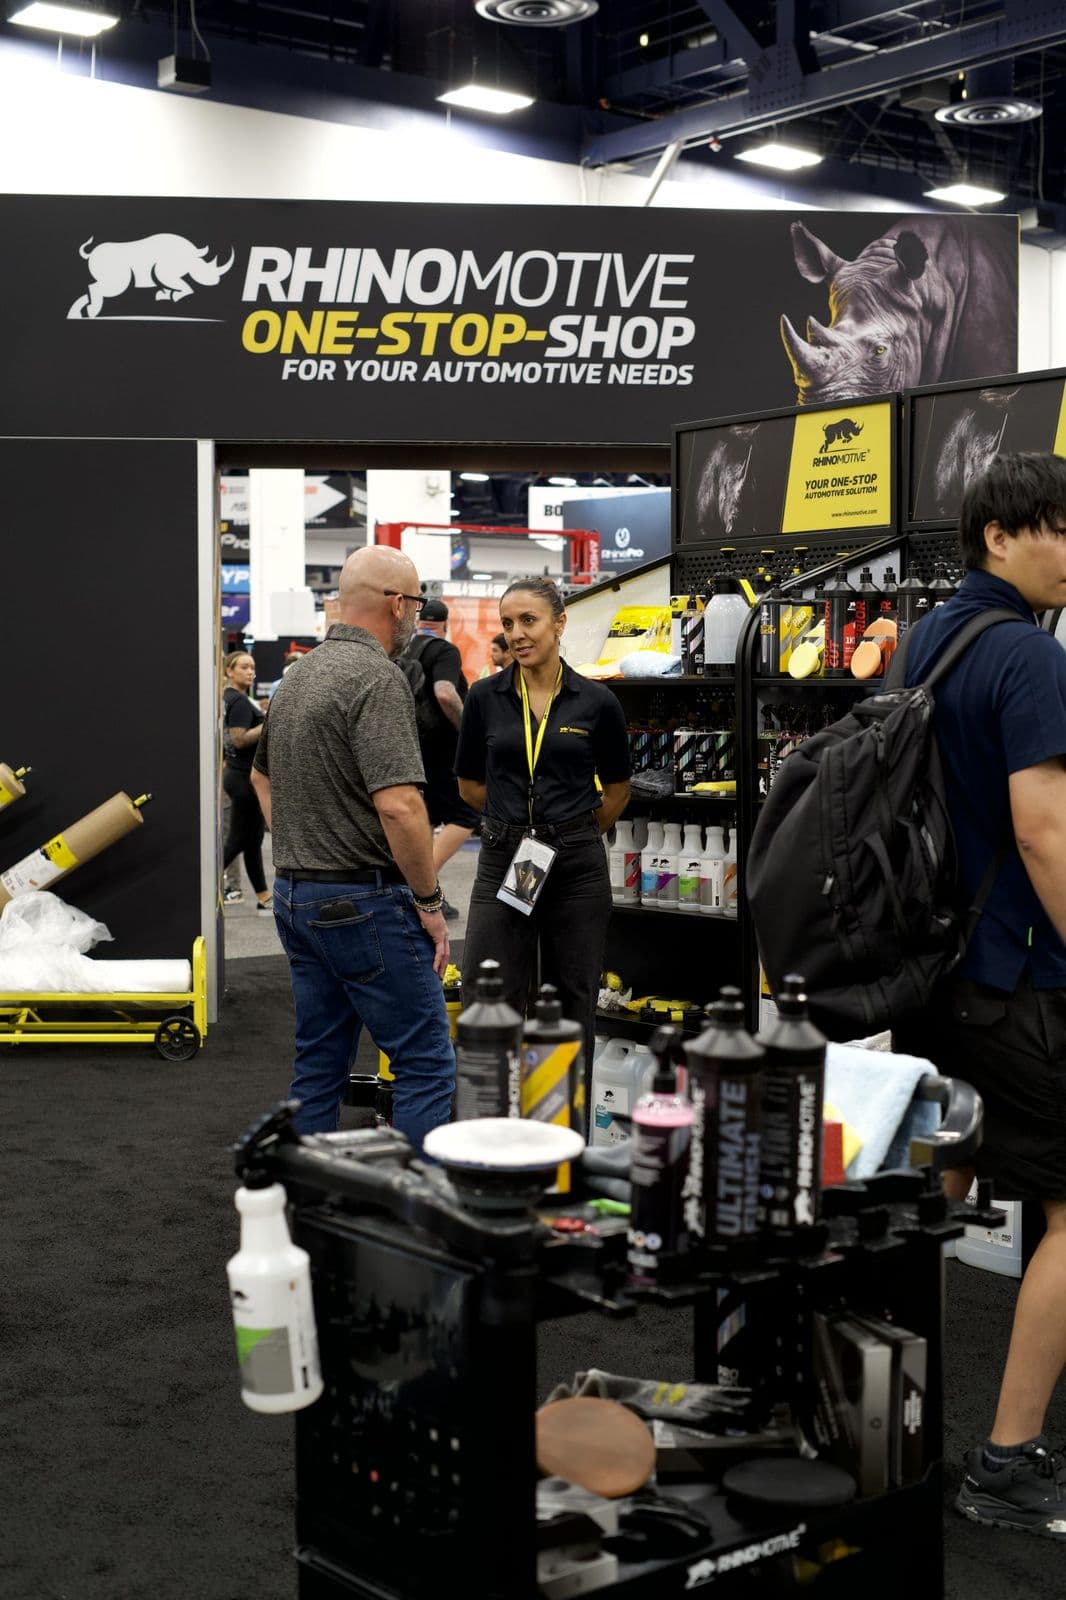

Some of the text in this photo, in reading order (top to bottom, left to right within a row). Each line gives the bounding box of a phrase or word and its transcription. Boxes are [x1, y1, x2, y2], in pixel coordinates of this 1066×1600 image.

[242, 247, 695, 308] RHINOMOTIVE
[242, 310, 695, 359] ONE-STOP-SHOP
[282, 359, 694, 385] FOR YOUR AUTOMOTIVE NEEDS
[812, 452, 867, 468] RHINOMOTIVE
[804, 485, 878, 500] AUTOMOTIVE SOLUTION
[805, 473, 878, 490] YOUR ONE-STOP
[716, 1080, 747, 1236] ULTIMATE
